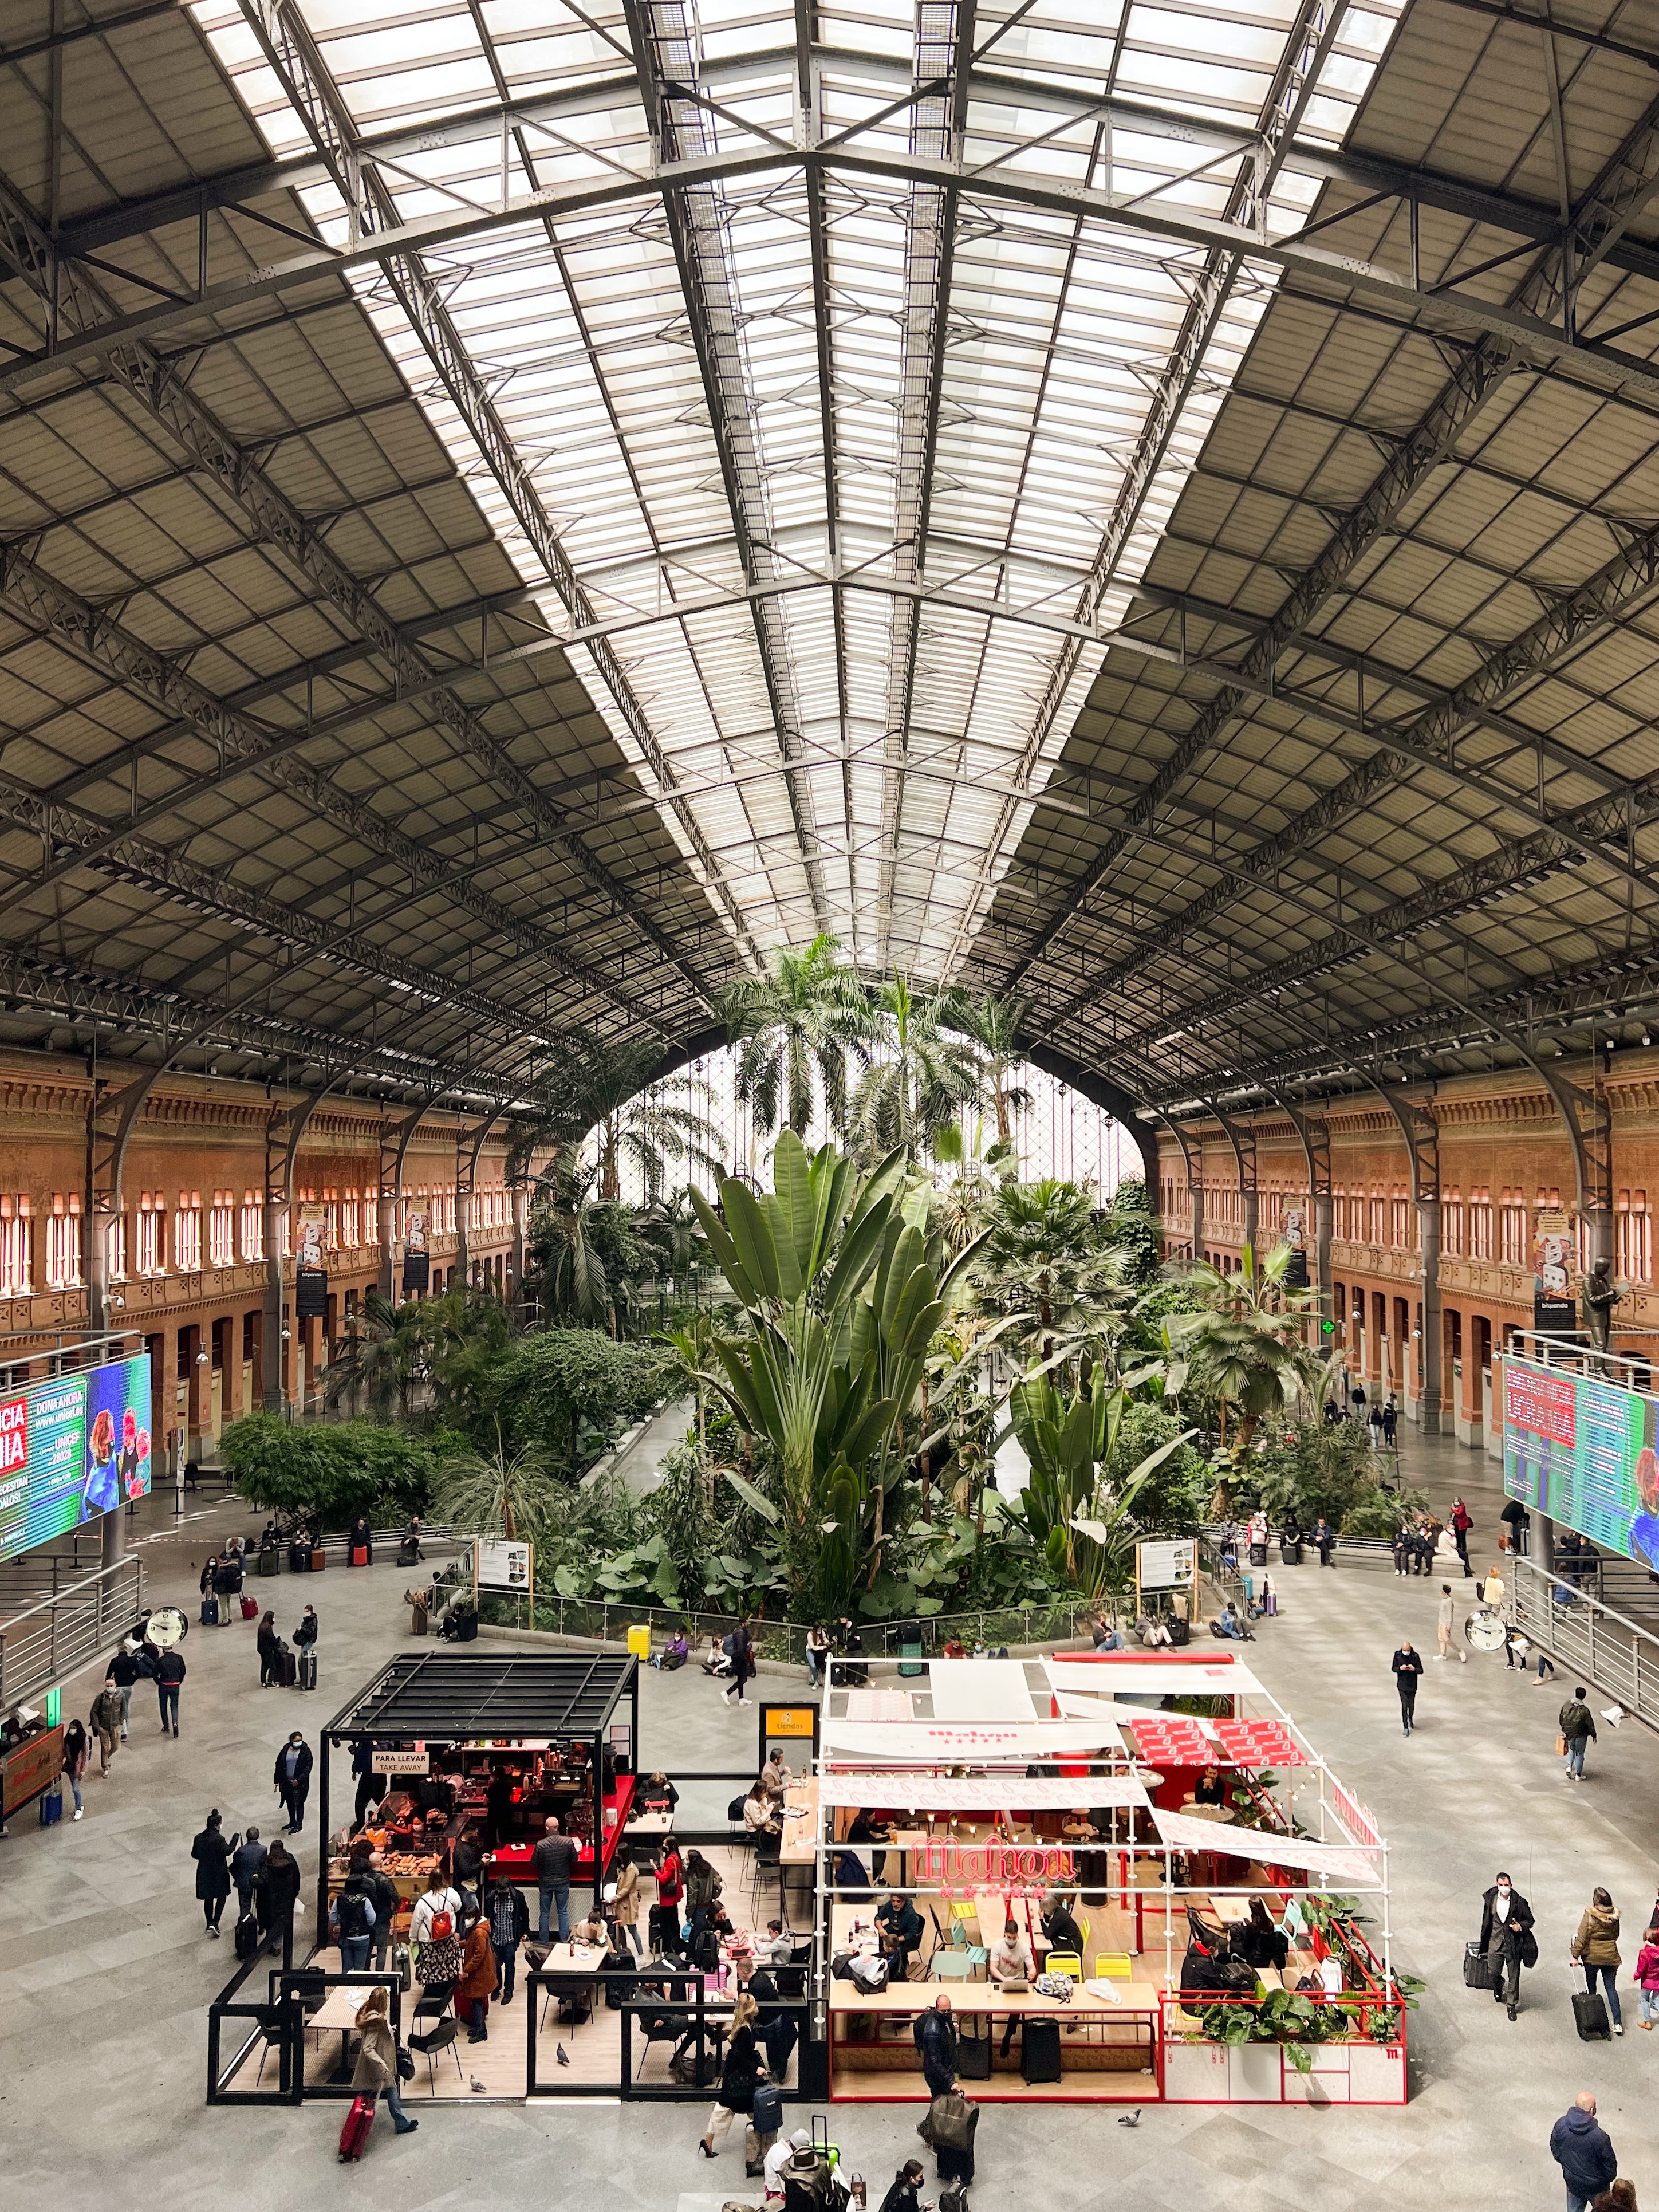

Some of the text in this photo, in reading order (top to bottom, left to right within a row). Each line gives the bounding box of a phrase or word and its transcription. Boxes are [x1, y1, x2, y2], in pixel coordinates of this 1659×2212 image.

[37, 1390, 83, 1415] DONA AHORA
[0, 1404, 25, 1432] CIA
[36, 1405, 84, 1429] www.unicef.es
[55, 1431, 80, 1450] UNICEF
[911, 1834, 1077, 1880] Mahou
